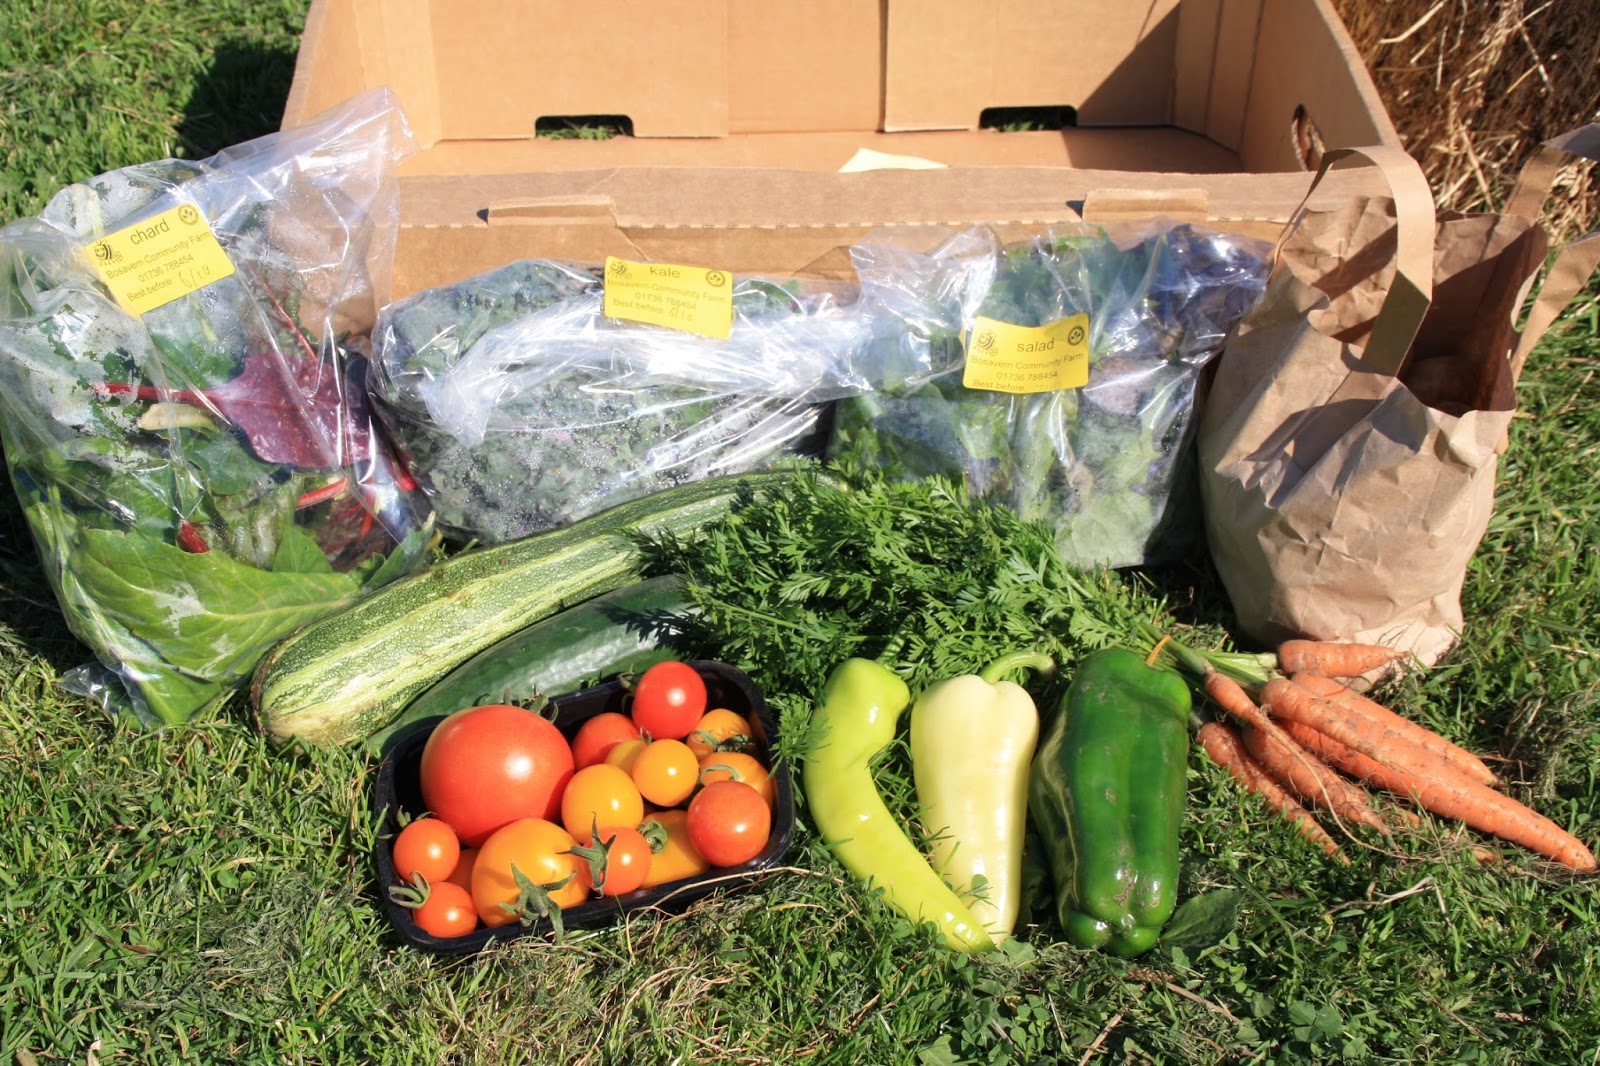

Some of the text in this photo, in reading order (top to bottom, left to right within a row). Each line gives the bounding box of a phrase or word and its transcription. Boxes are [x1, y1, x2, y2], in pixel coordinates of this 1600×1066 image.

[130, 218, 170, 245] chard
[144, 242, 190, 264] Community
[189, 230, 210, 244] Farm
[138, 253, 194, 282] 01736 788454
[650, 266, 680, 278] kale
[127, 289, 147, 301] Best
[635, 292, 696, 309] 01736 788454
[652, 284, 700, 300] Community
[703, 292, 725, 303] Farm
[613, 298, 633, 307] Best
[1017, 338, 1055, 352] salad
[1016, 359, 1062, 370] Community
[1063, 353, 1083, 362] Farm
[997, 371, 1058, 381] 01736 788454
